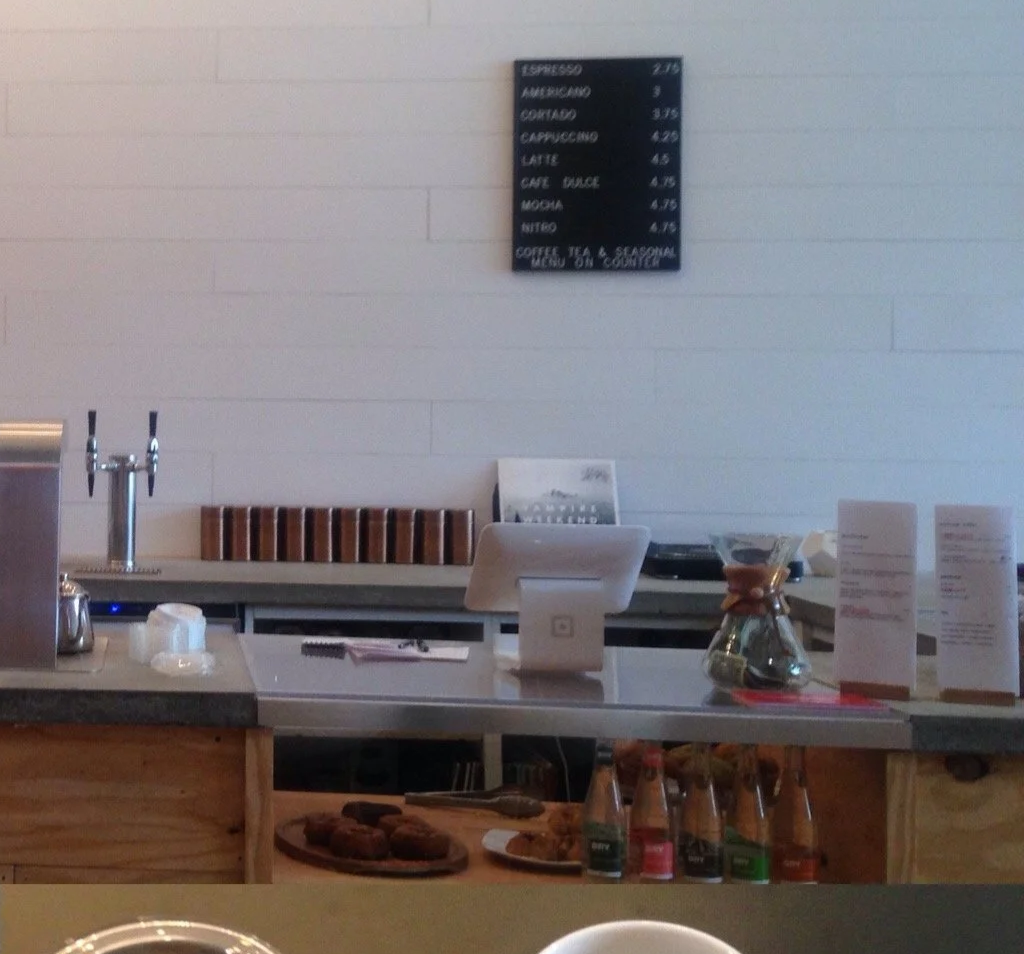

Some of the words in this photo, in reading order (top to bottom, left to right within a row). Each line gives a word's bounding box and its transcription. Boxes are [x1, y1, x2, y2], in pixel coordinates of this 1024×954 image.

[522, 64, 582, 76] ESPRESSO
[654, 63, 680, 75] 2.75
[522, 86, 591, 98] AMERICANO
[521, 109, 577, 121] CORTADO
[521, 132, 598, 144] CAPPUCCINO
[652, 131, 679, 143] 4.25
[522, 154, 559, 166] LATTE
[652, 154, 670, 165] 4.5
[522, 178, 549, 189] CAFE
[564, 177, 600, 189] DULCE
[651, 176, 676, 188] 4.75
[522, 200, 563, 211] MOCHA
[650, 200, 677, 211] 4.75
[522, 223, 557, 234] NITRO
[650, 222, 677, 234] 4.75
[517, 247, 559, 258] COFFEE
[569, 247, 590, 258] TEA
[598, 247, 606, 258] &
[616, 247, 676, 258] SEASONAL
[532, 257, 565, 268] MENU
[576, 257, 593, 268] ON
[604, 257, 660, 268] COUNTER
[524, 504, 596, 512] VAMPIRE
[523, 515, 598, 524] WEEKEND
[591, 842, 610, 851] DRY
